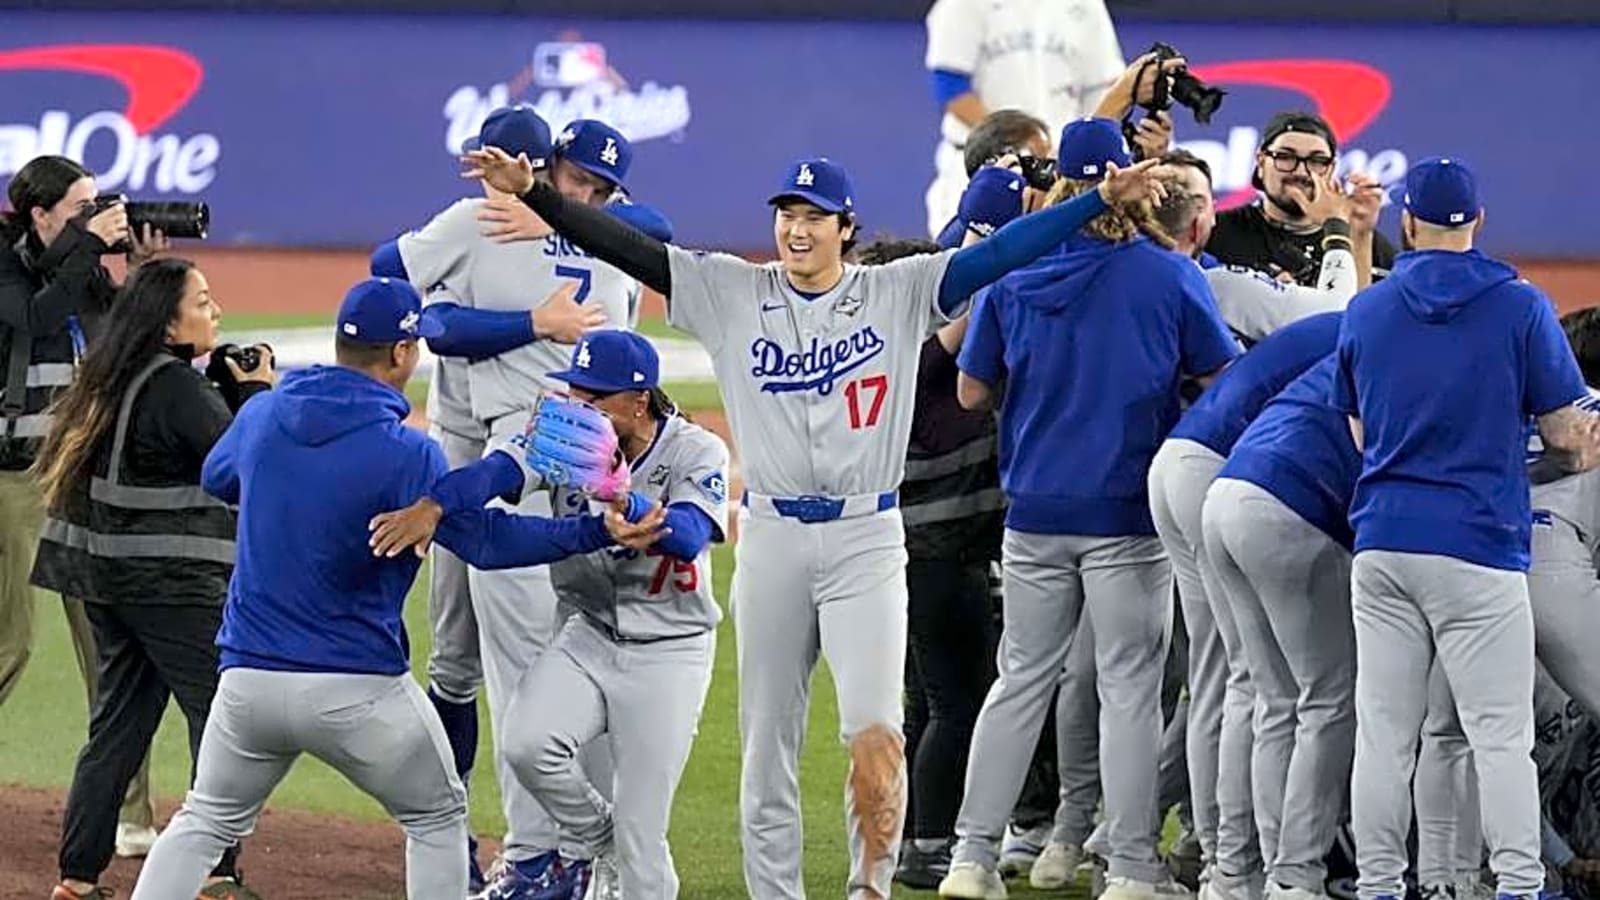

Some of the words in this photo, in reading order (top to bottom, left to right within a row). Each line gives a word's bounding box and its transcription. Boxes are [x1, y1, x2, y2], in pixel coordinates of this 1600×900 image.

[554, 264, 592, 306] 7
[751, 326, 885, 396] Dodgers
[844, 375, 888, 429] 17
